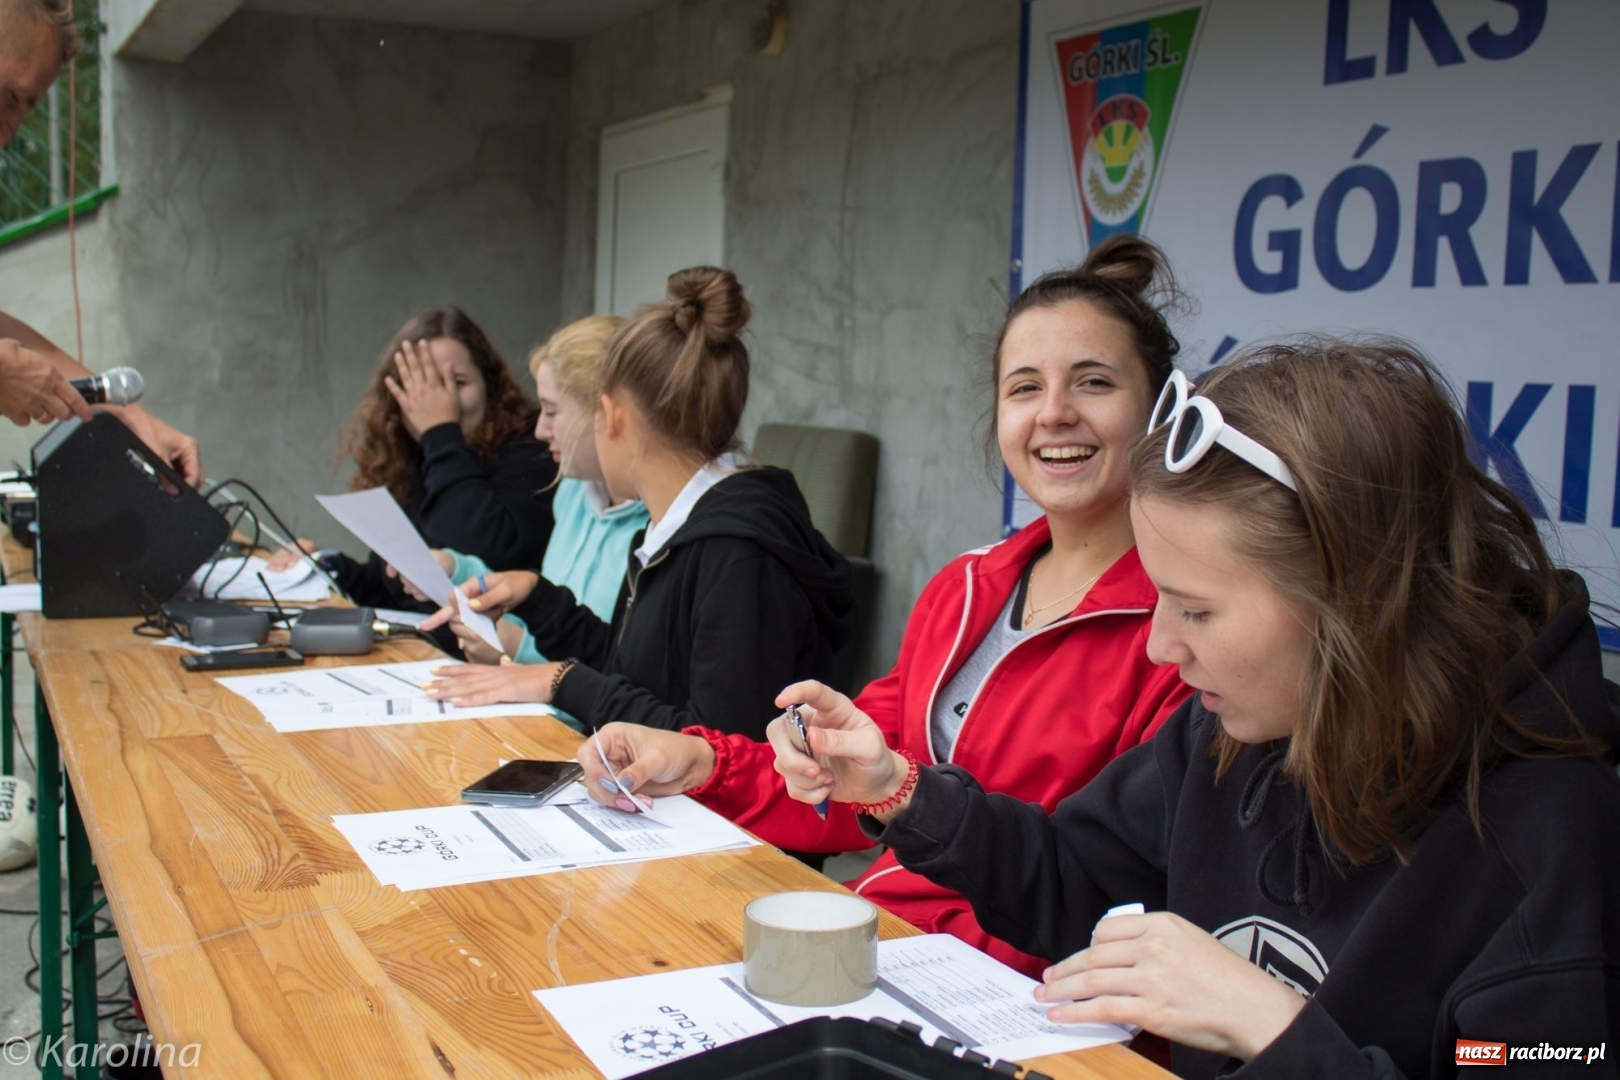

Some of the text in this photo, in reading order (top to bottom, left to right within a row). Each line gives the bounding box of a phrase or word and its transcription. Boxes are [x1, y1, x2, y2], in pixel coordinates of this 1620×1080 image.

[1069, 30, 1181, 83] GÓRKI ŚL.
[1098, 98, 1138, 126] LKS
[415, 825, 438, 839] CUP
[658, 1005, 697, 1029] CUP
